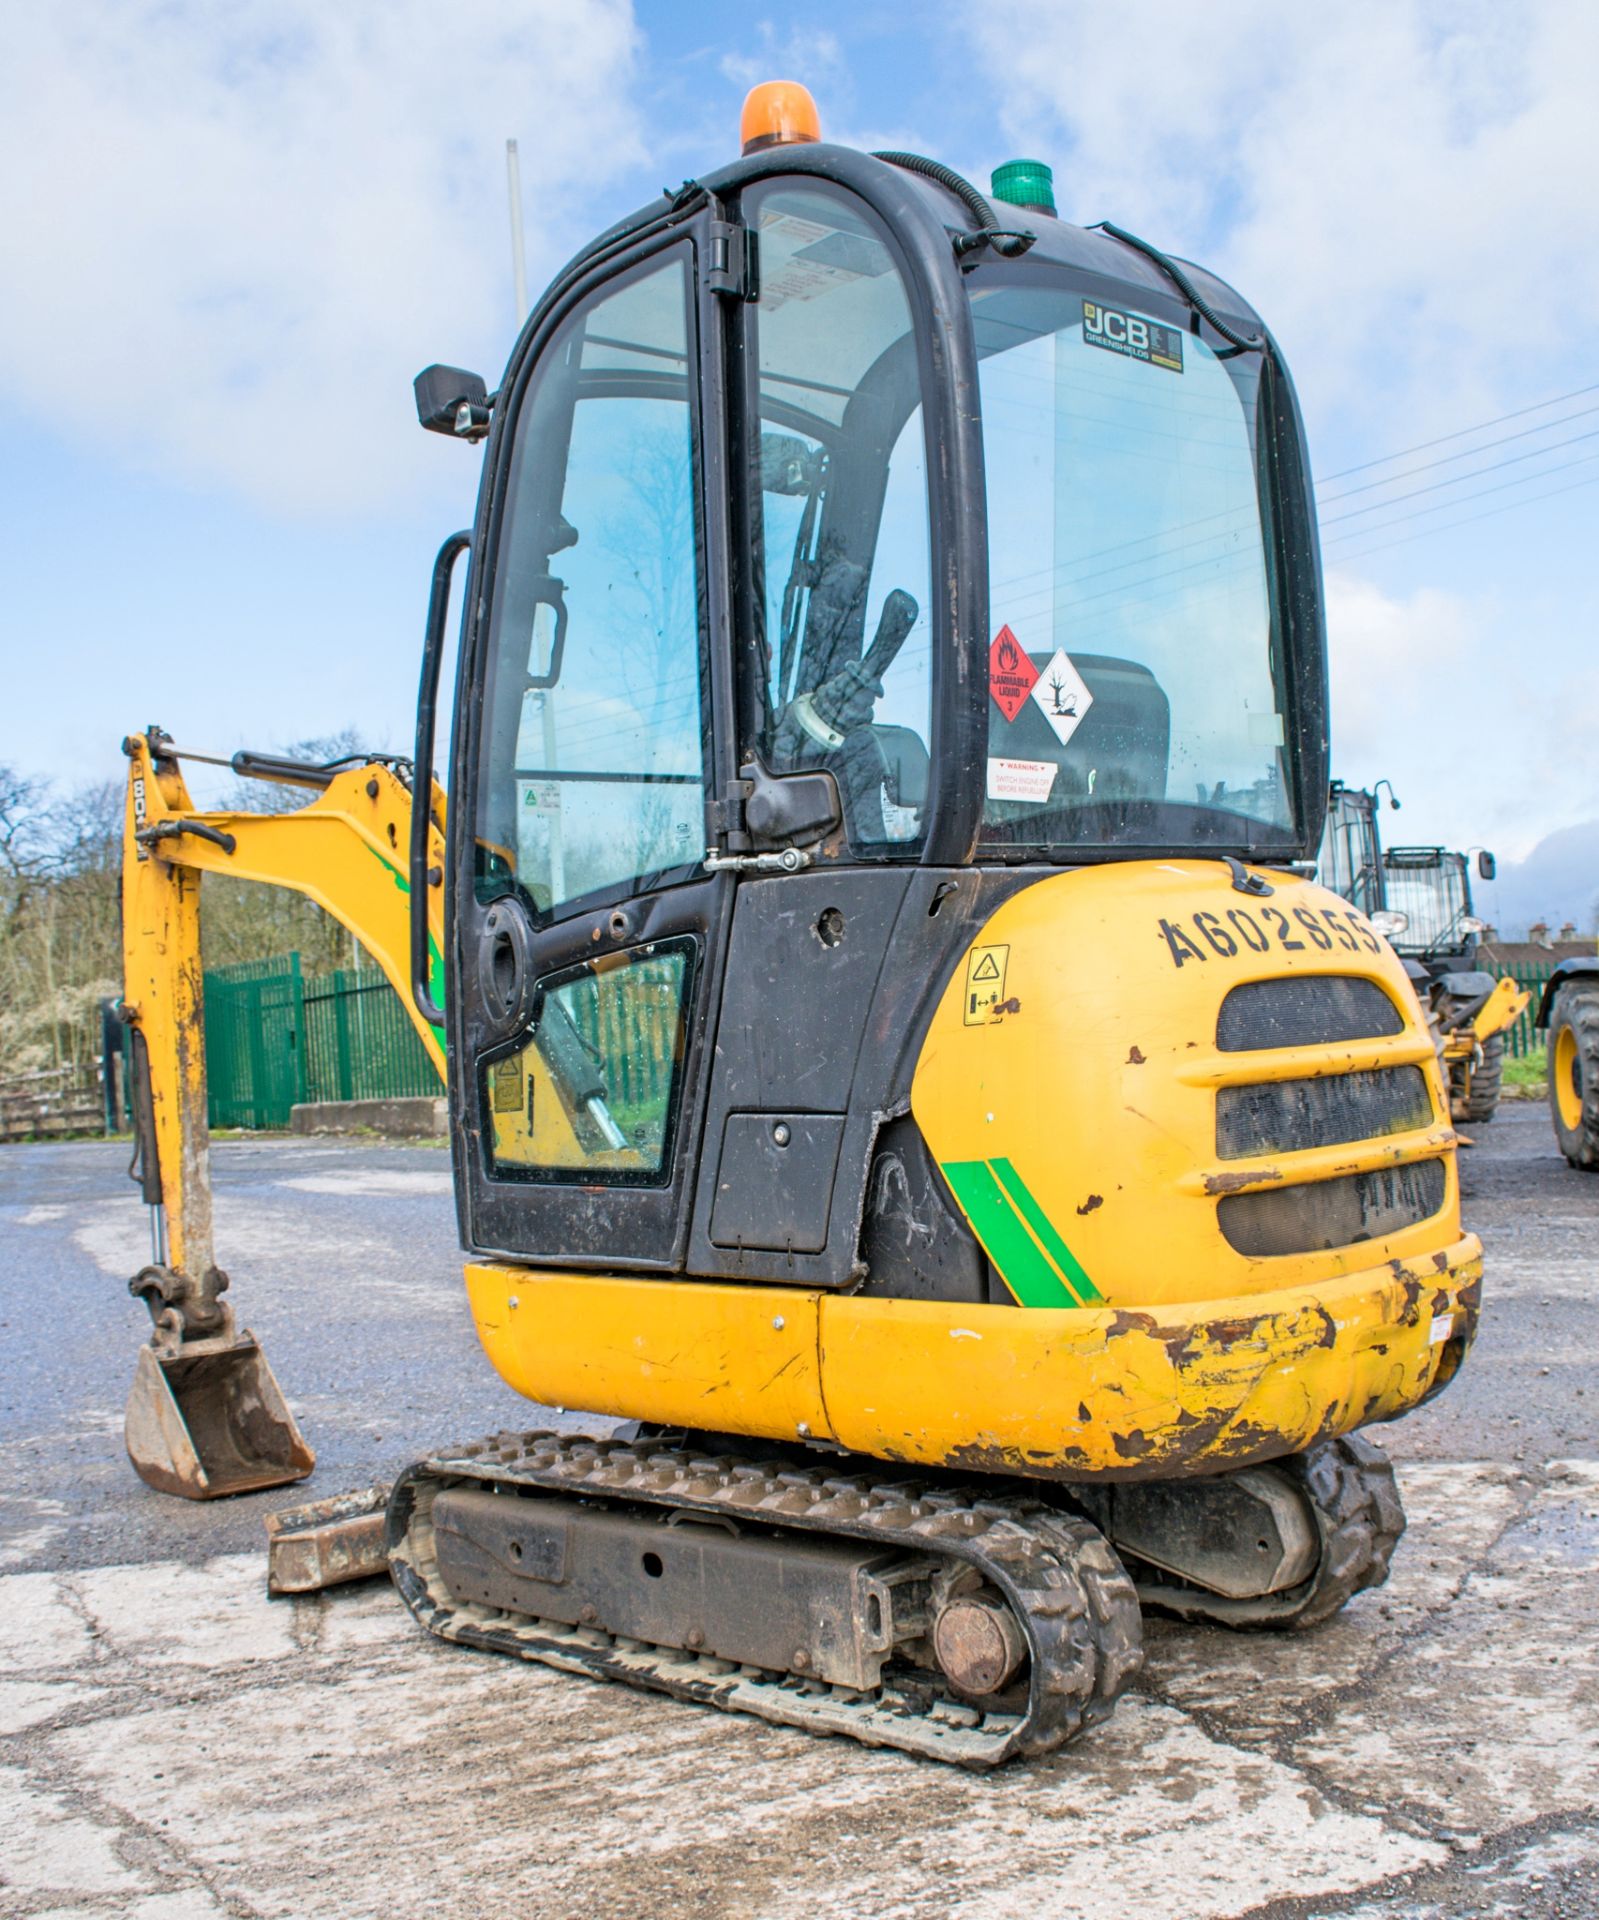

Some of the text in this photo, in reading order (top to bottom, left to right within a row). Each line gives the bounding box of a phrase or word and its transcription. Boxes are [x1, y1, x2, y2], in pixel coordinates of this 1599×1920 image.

[1085, 306, 1149, 350] JCB
[999, 686, 1020, 697] LIQUID
[1007, 700, 1013, 711] 3
[1007, 762, 1039, 772] WARNING
[1158, 907, 1381, 968] A602855
